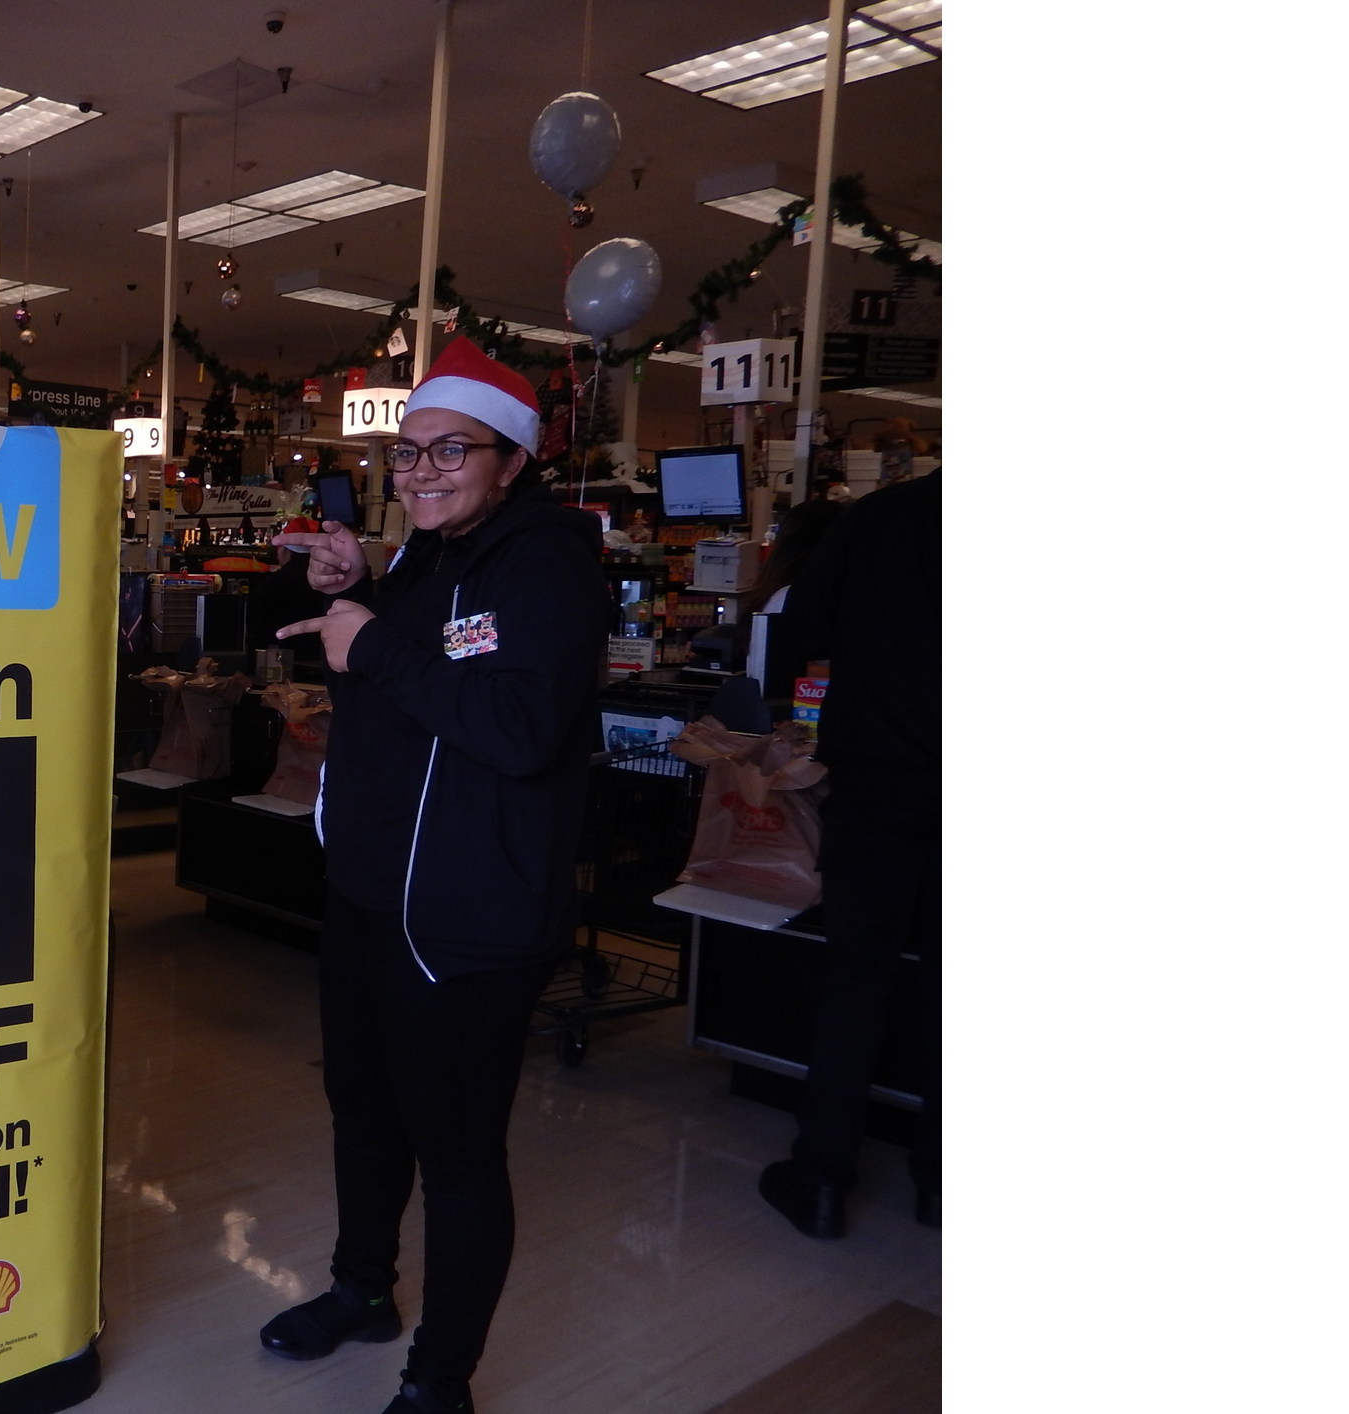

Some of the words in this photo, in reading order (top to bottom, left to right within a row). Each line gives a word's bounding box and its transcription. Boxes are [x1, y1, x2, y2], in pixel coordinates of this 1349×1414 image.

[859, 295, 889, 320] 11
[711, 353, 752, 391] 11
[765, 353, 790, 388] 11
[74, 392, 101, 408] lane
[347, 399, 375, 426] 10
[381, 399, 407, 425] 10
[124, 428, 134, 448] 9
[150, 427, 159, 448] 9
[217, 483, 249, 504] Wine
[240, 494, 273, 512] Cellar
